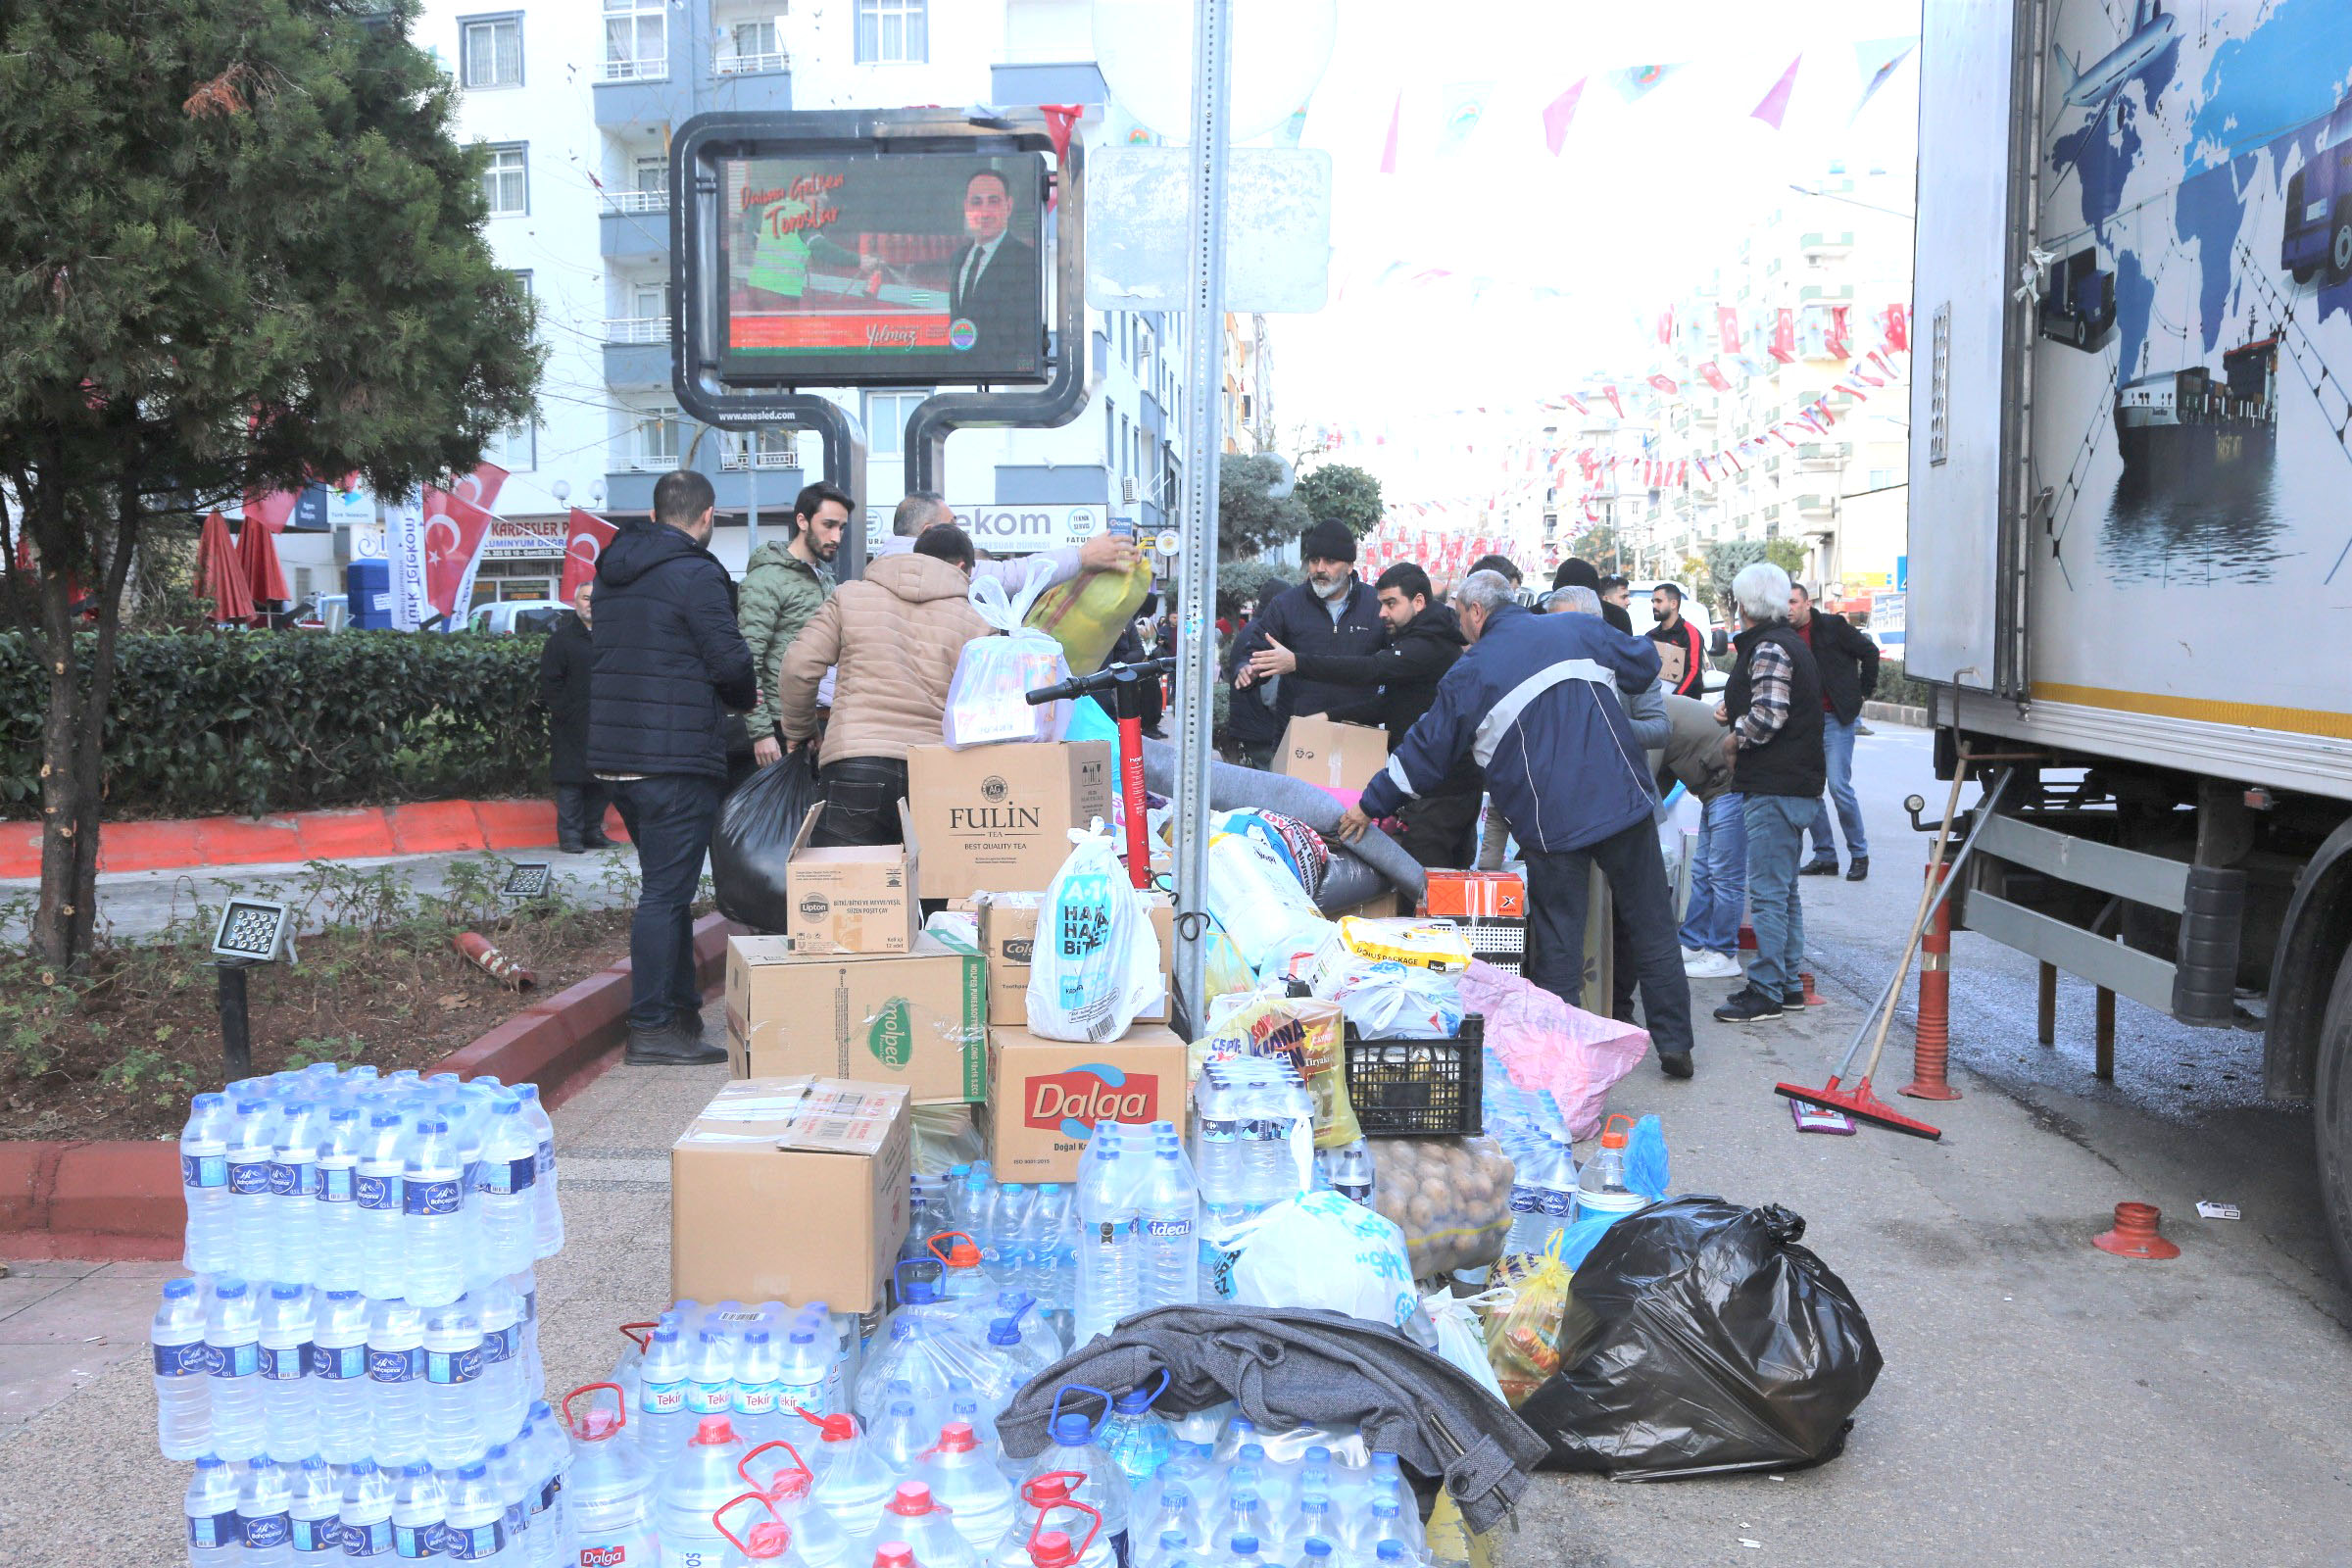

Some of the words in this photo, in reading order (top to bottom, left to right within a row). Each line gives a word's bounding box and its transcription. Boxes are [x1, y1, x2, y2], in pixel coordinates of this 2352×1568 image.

[764, 200, 839, 239] Toroslar
[866, 323, 917, 352] Yılmaz
[718, 411, 796, 421] www.enesled.com
[950, 801, 1041, 829] FULİN
[1006, 942, 1034, 956] Colg
[1383, 955, 1418, 965] PACKAGE
[885, 1002, 906, 1067] molped
[1305, 1055, 1331, 1067] Tiryaki
[1032, 1081, 1148, 1122] Dalga
[1054, 1143, 1076, 1152] Doğal
[1152, 1219, 1190, 1235] ideal
[657, 1392, 681, 1405] Tekir
[746, 1393, 771, 1406] Tekir
[583, 1549, 622, 1566] Dalga
